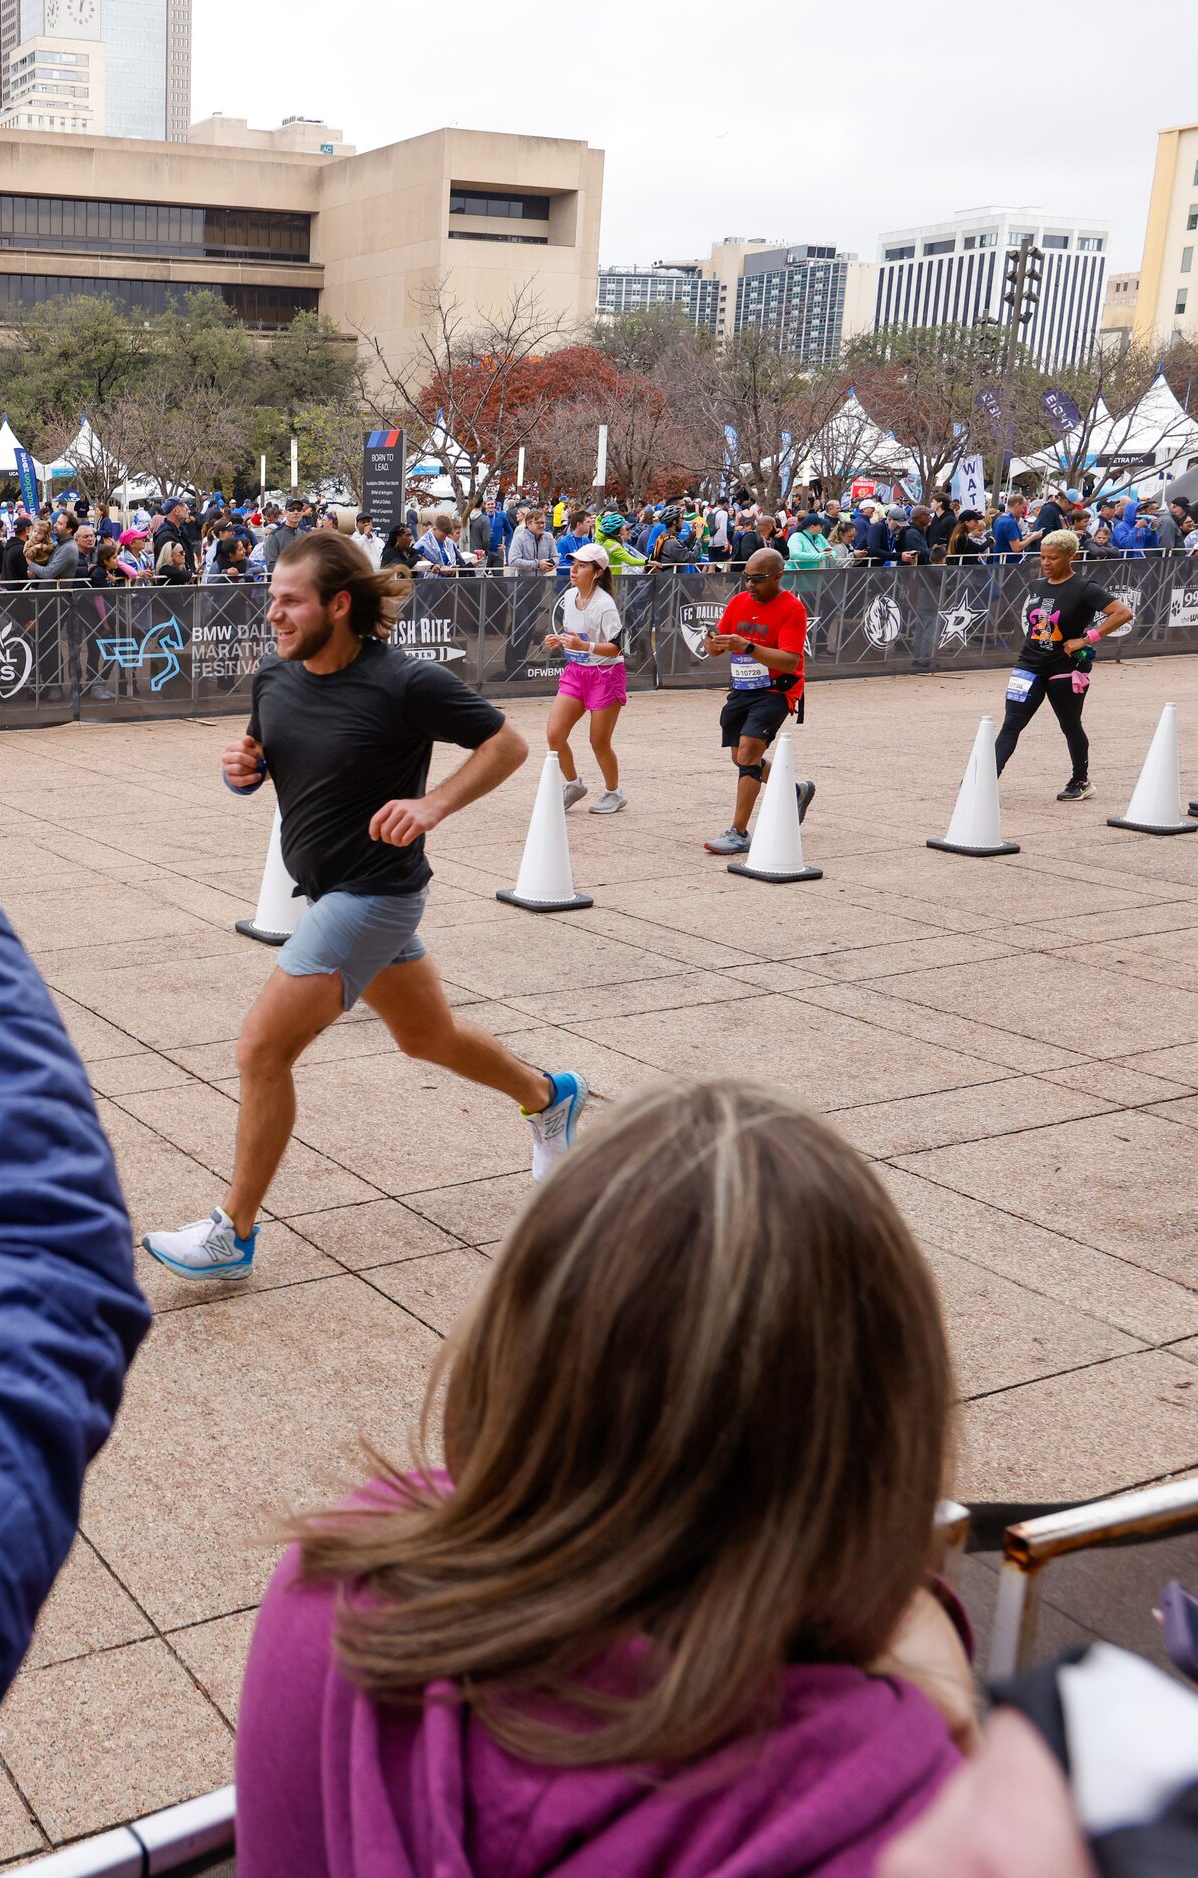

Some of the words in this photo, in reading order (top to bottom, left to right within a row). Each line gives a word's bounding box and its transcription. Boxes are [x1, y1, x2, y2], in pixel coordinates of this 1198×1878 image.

[20, 452, 30, 473] zone
[371, 453, 386, 462] BORN
[386, 453, 394, 461] TO
[374, 463, 390, 471] LEAD.
[24, 473, 35, 507] nutrition
[963, 461, 977, 511] WAT
[683, 607, 693, 621] FC
[696, 605, 724, 619] DALLAS
[192, 625, 232, 642] BMW
[237, 623, 279, 639] DALL
[420, 617, 452, 644] RITE
[191, 640, 278, 660] MARATHO
[191, 659, 261, 678] FESTIVA
[740, 669, 762, 677] 10728
